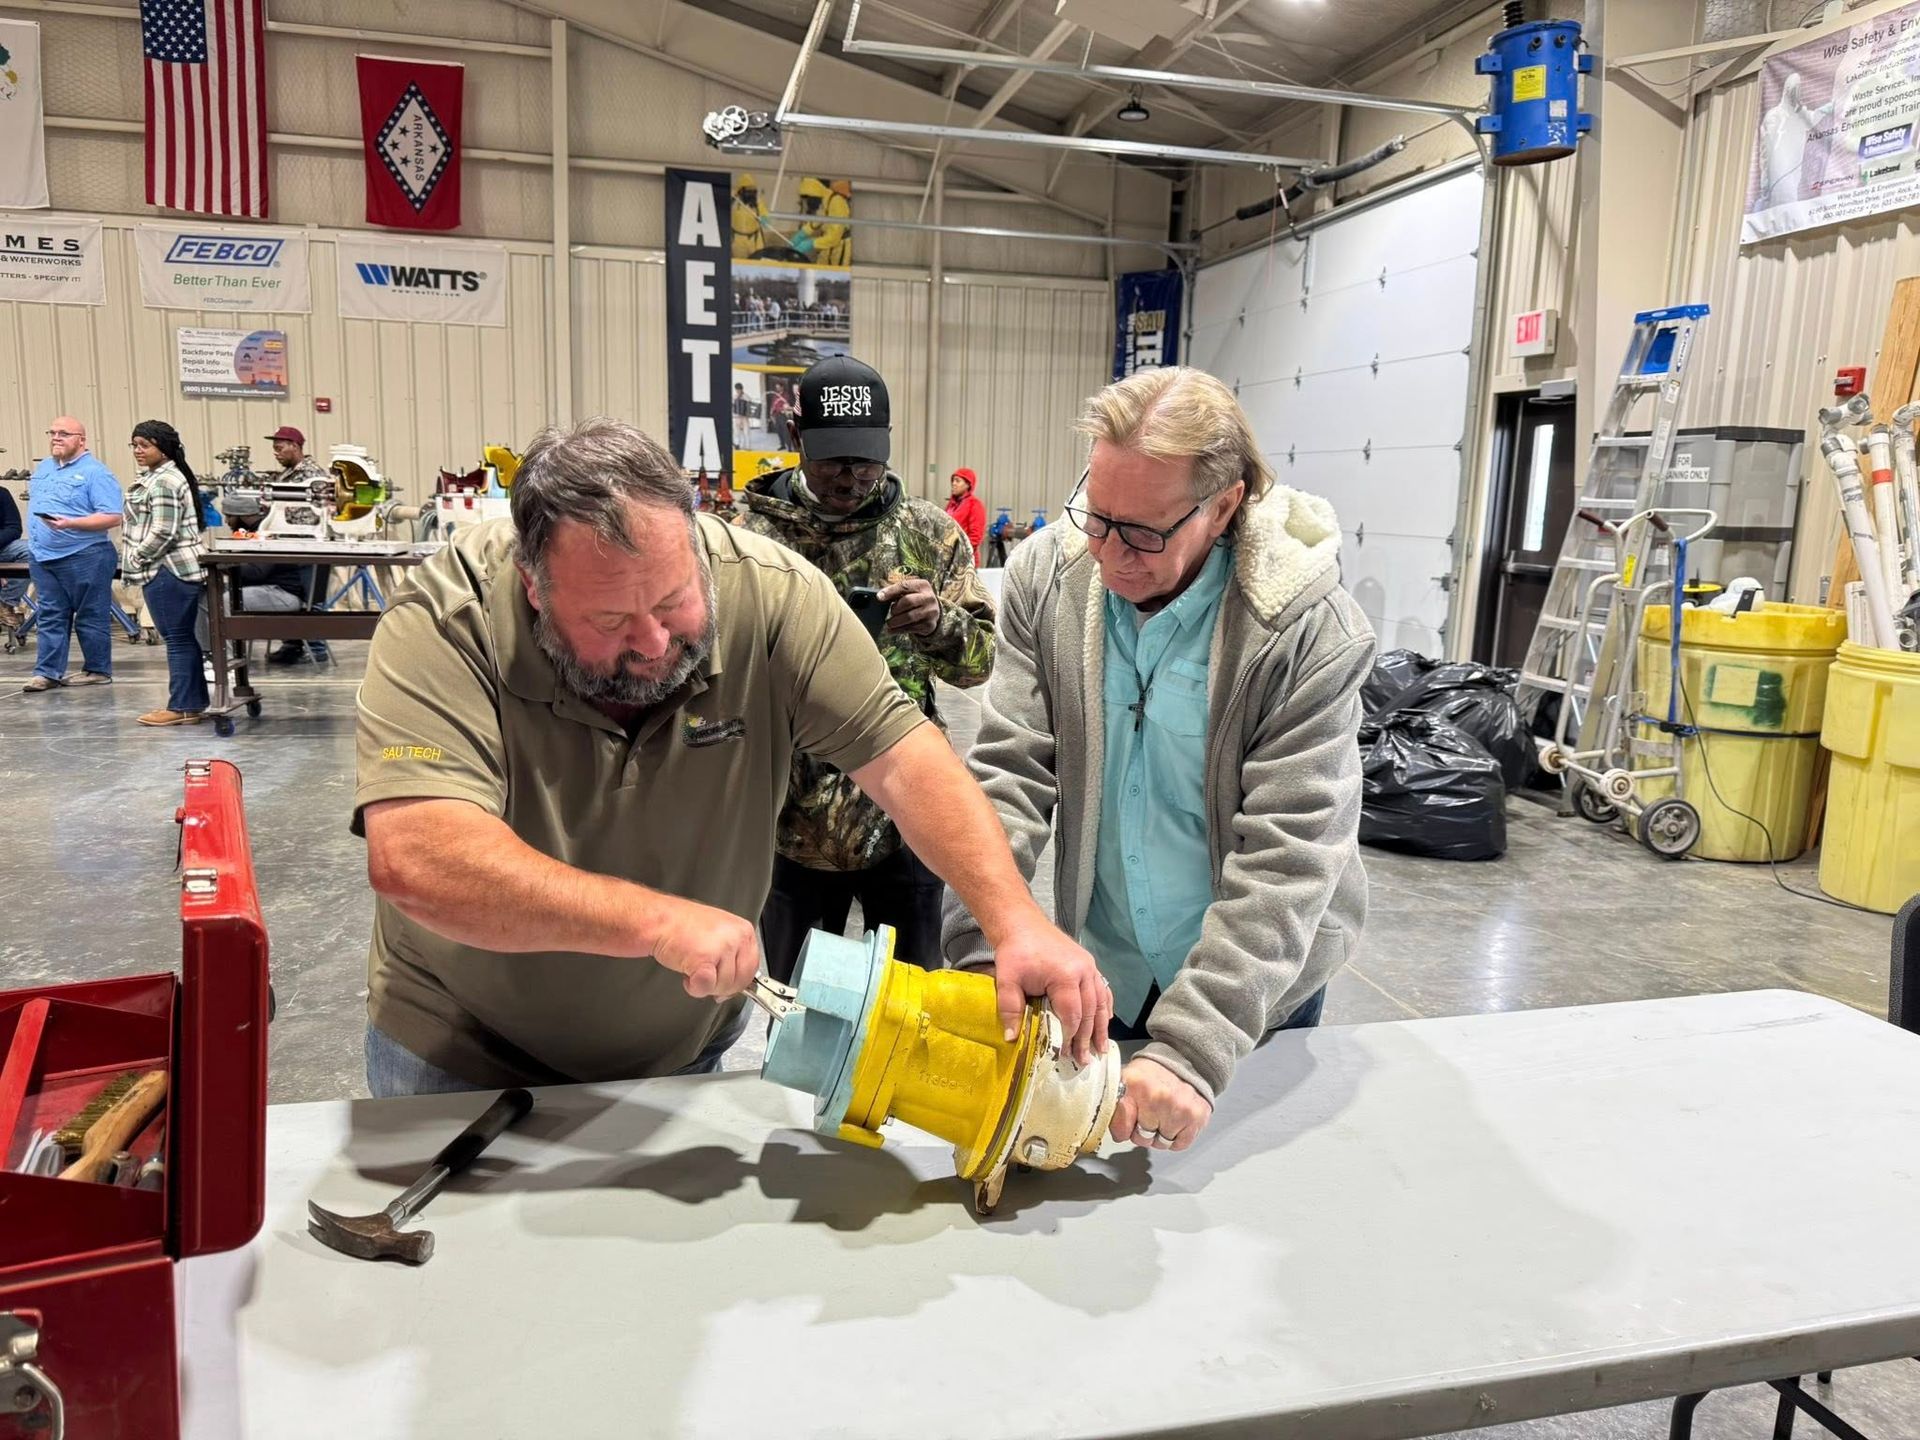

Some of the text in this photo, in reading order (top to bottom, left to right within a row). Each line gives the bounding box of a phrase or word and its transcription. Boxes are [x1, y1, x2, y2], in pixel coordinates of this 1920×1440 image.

[1823, 43, 1848, 59] Wise
[1851, 29, 1885, 49] Safety
[1888, 23, 1896, 36] &
[1852, 90, 1874, 102] Waste
[1845, 107, 1857, 118] are
[1859, 98, 1882, 115] proud
[1841, 109, 1898, 131] Environmental
[413, 114, 425, 181] ARKANSAS
[5, 234, 80, 252] MES
[175, 241, 273, 262] FEBCO
[1, 254, 82, 267] & WATERWORKS
[34, 274, 69, 282] SPECIFY
[173, 273, 281, 289] Better Than Ever
[390, 265, 480, 292] WATTS
[1135, 310, 1166, 332] SAU
[1517, 313, 1541, 344] EXIT
[678, 181, 722, 479] AETA
[181, 348, 234, 357] Backflow Parts
[182, 357, 221, 366] Repair Info
[202, 367, 230, 376] Support
[820, 385, 872, 402] JESUS
[823, 400, 872, 417] FIRST
[1677, 455, 1690, 466] FOR
[1664, 470, 1708, 480] AINING ONLY
[382, 746, 441, 761] SAU TECH
